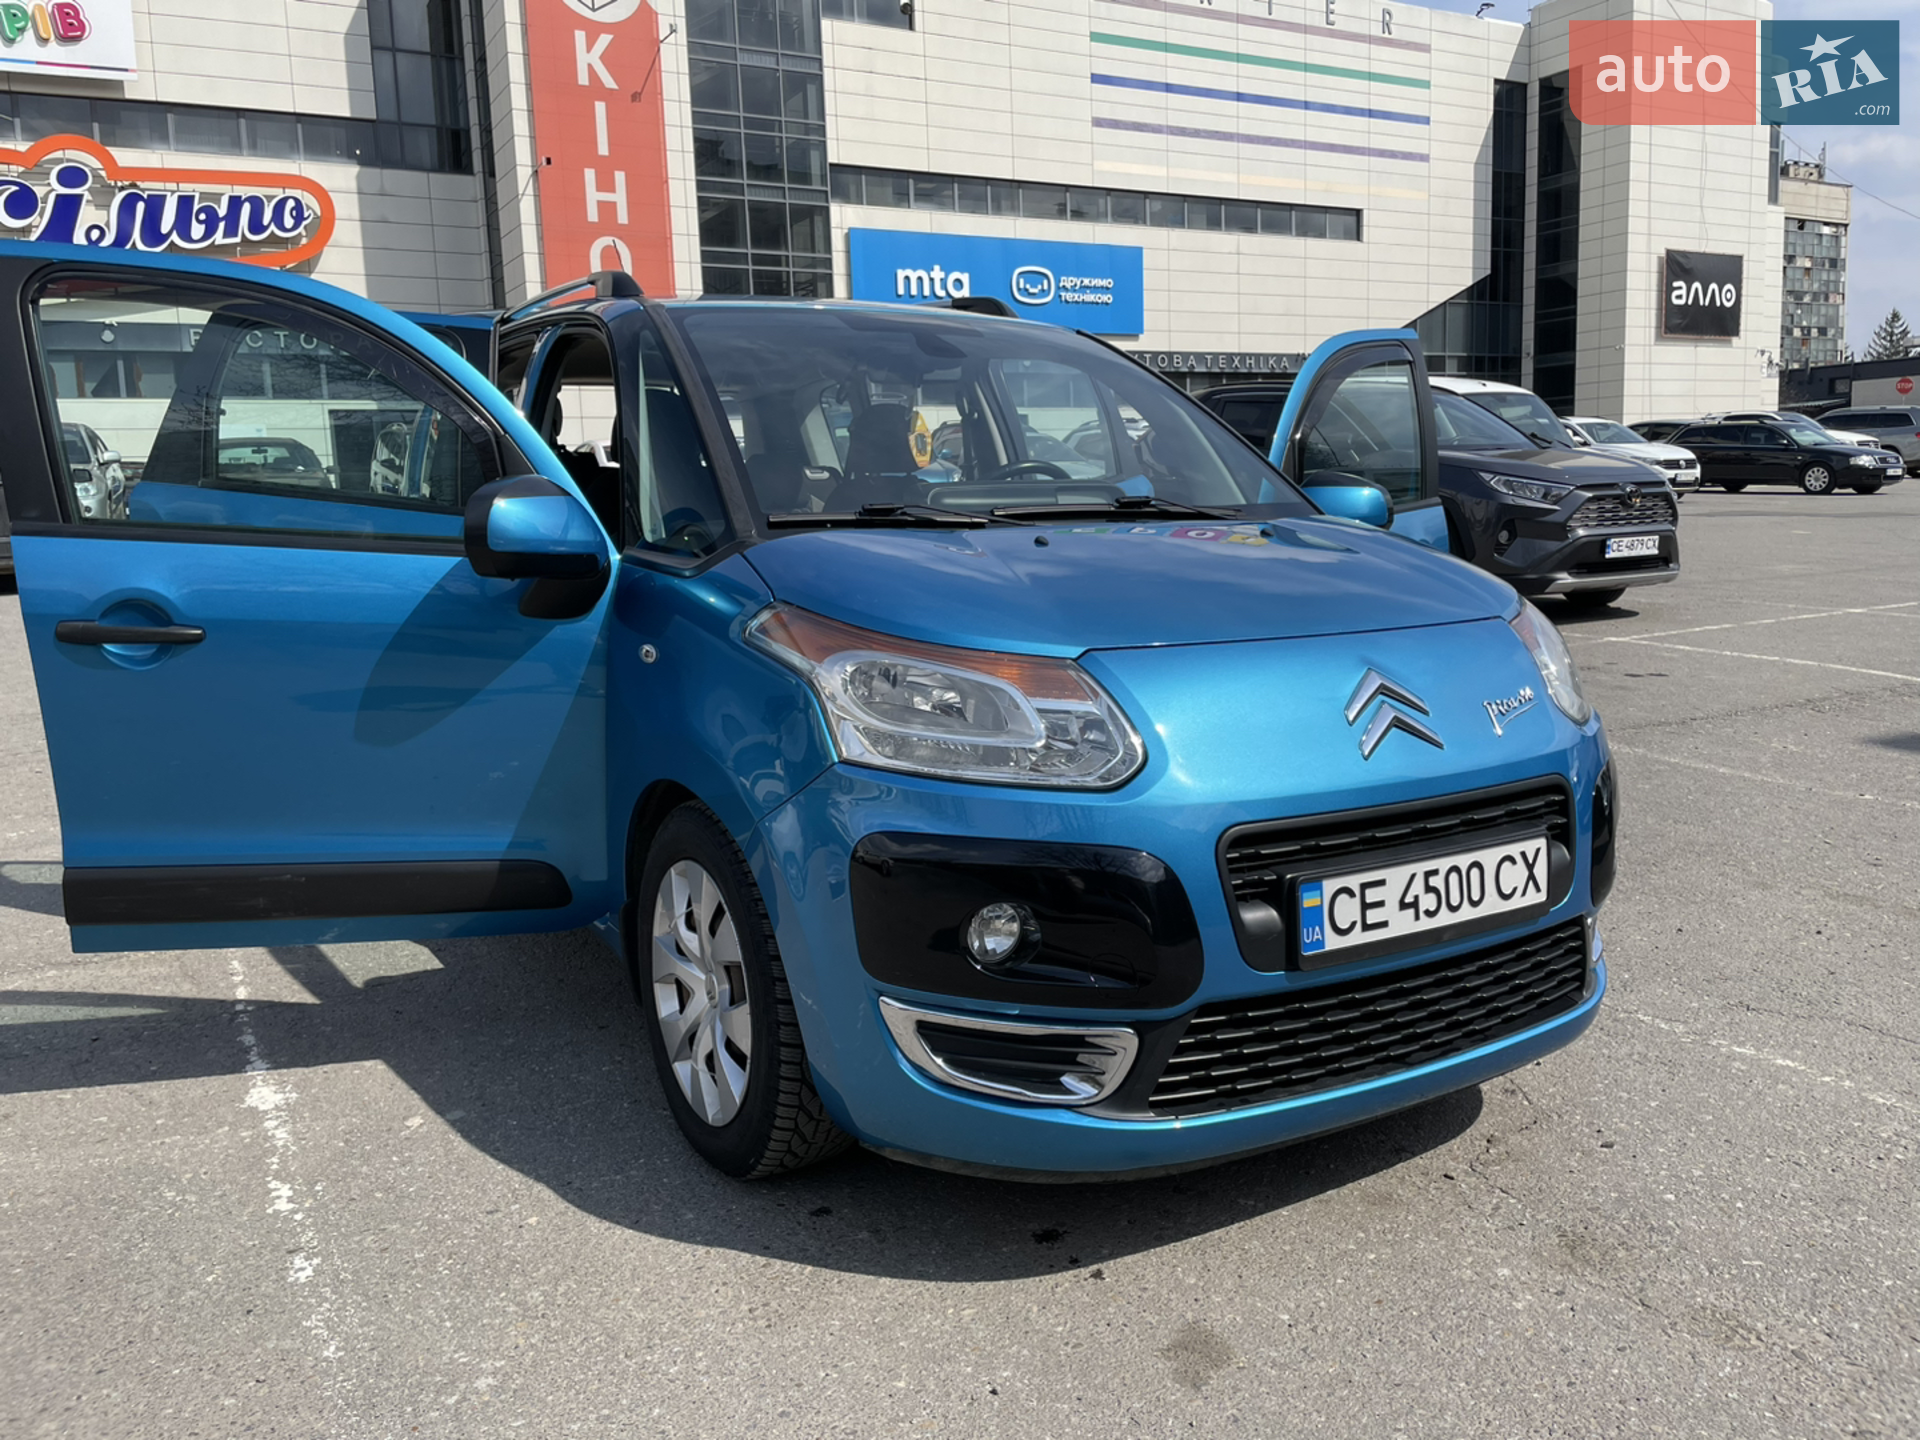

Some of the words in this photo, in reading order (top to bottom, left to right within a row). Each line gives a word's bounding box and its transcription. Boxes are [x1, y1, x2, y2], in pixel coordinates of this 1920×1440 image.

[574, 29, 633, 274] КІНО
[896, 264, 970, 298] mta
[1060, 276, 1114, 290] дружимо
[1059, 290, 1113, 304] технікою
[1133, 353, 1197, 368] ТОВА
[1204, 354, 1290, 369] ТЕХНІКА
[1611, 540, 1624, 553] CE
[1645, 537, 1658, 550] CX
[1328, 878, 1389, 937] CE
[1398, 860, 1485, 922] 4500
[1494, 847, 1542, 900] CX
[1303, 925, 1323, 943] UA
